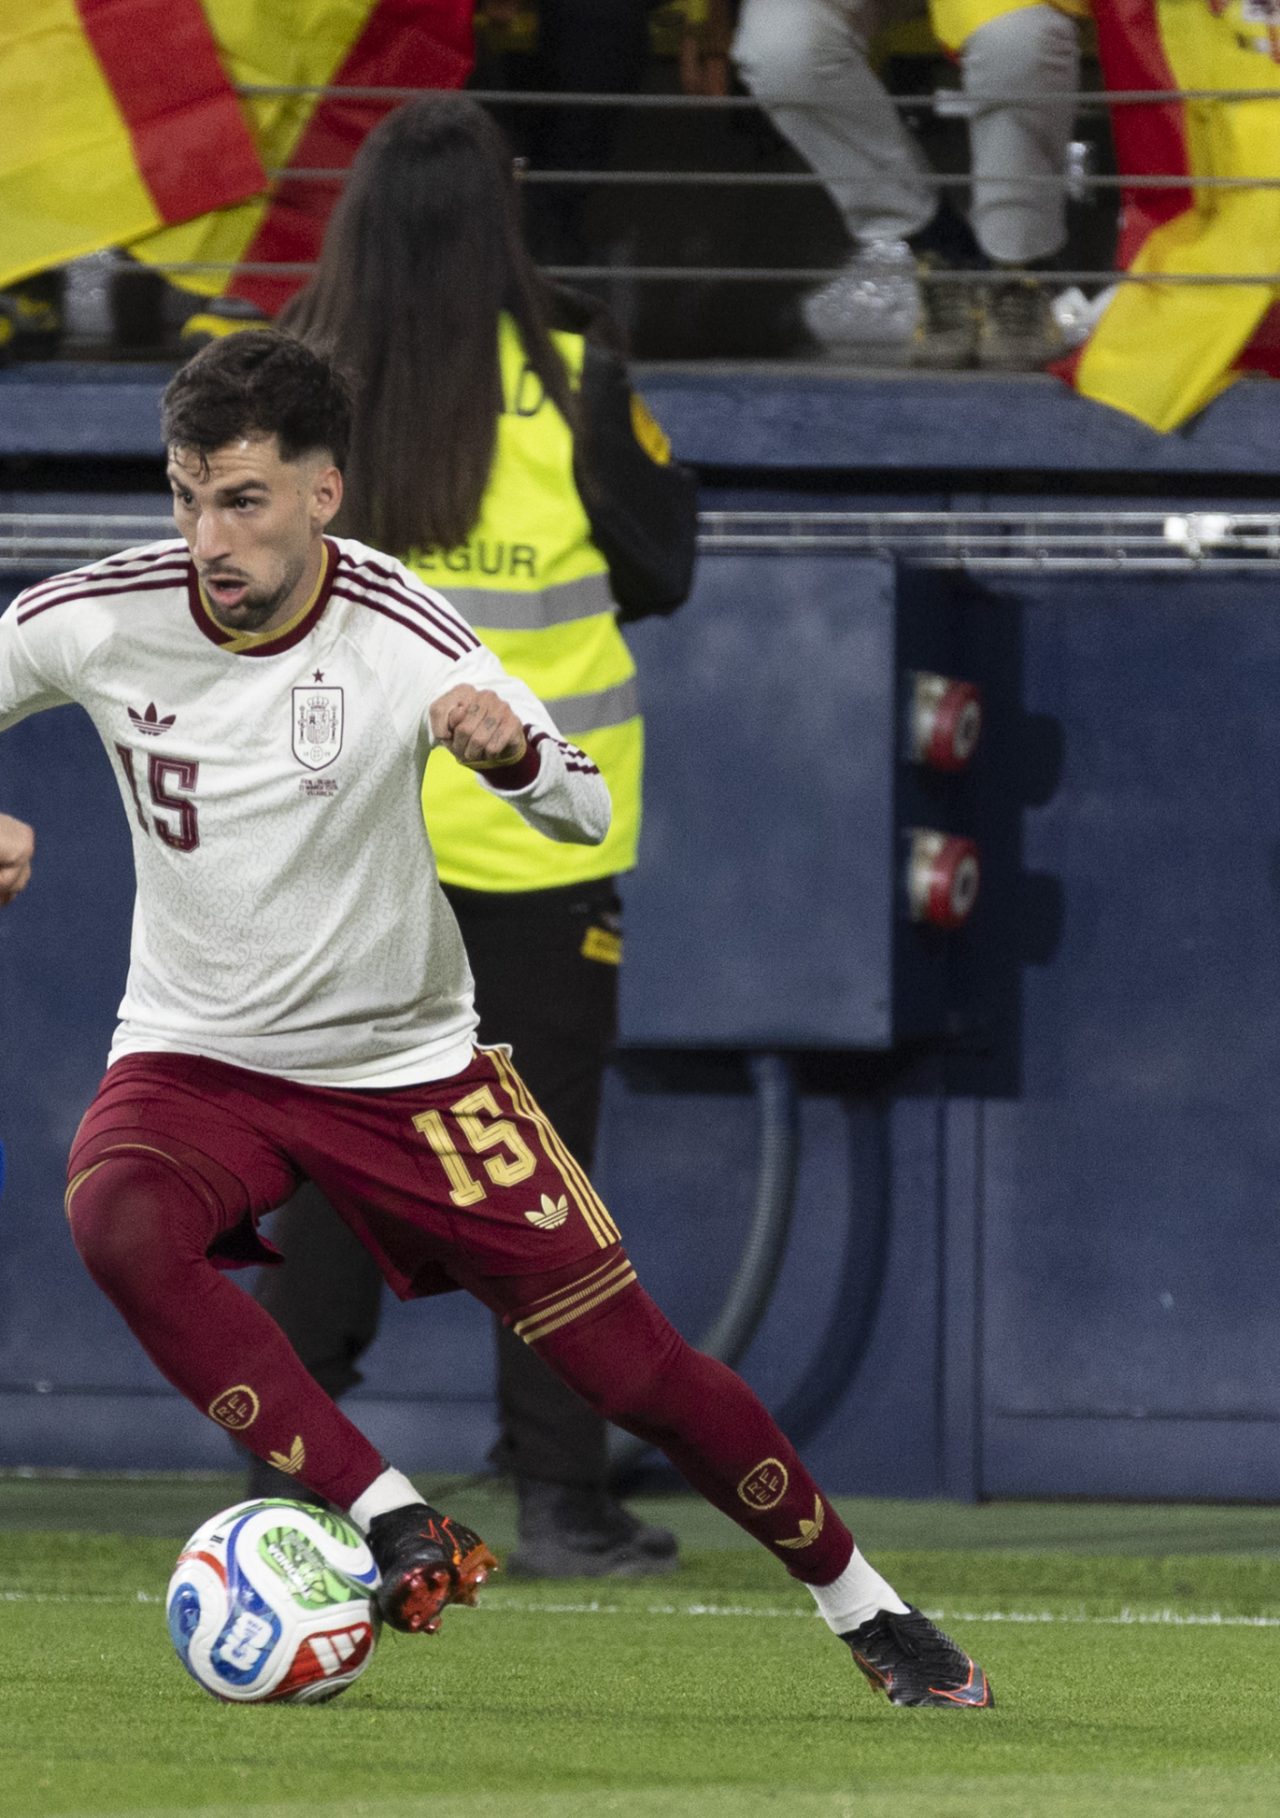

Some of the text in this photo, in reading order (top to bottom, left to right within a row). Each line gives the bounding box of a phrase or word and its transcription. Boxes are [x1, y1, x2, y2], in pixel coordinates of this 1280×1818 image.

[404, 540, 537, 578] EGUR
[114, 741, 200, 853] 15
[411, 1085, 537, 1207] 15
